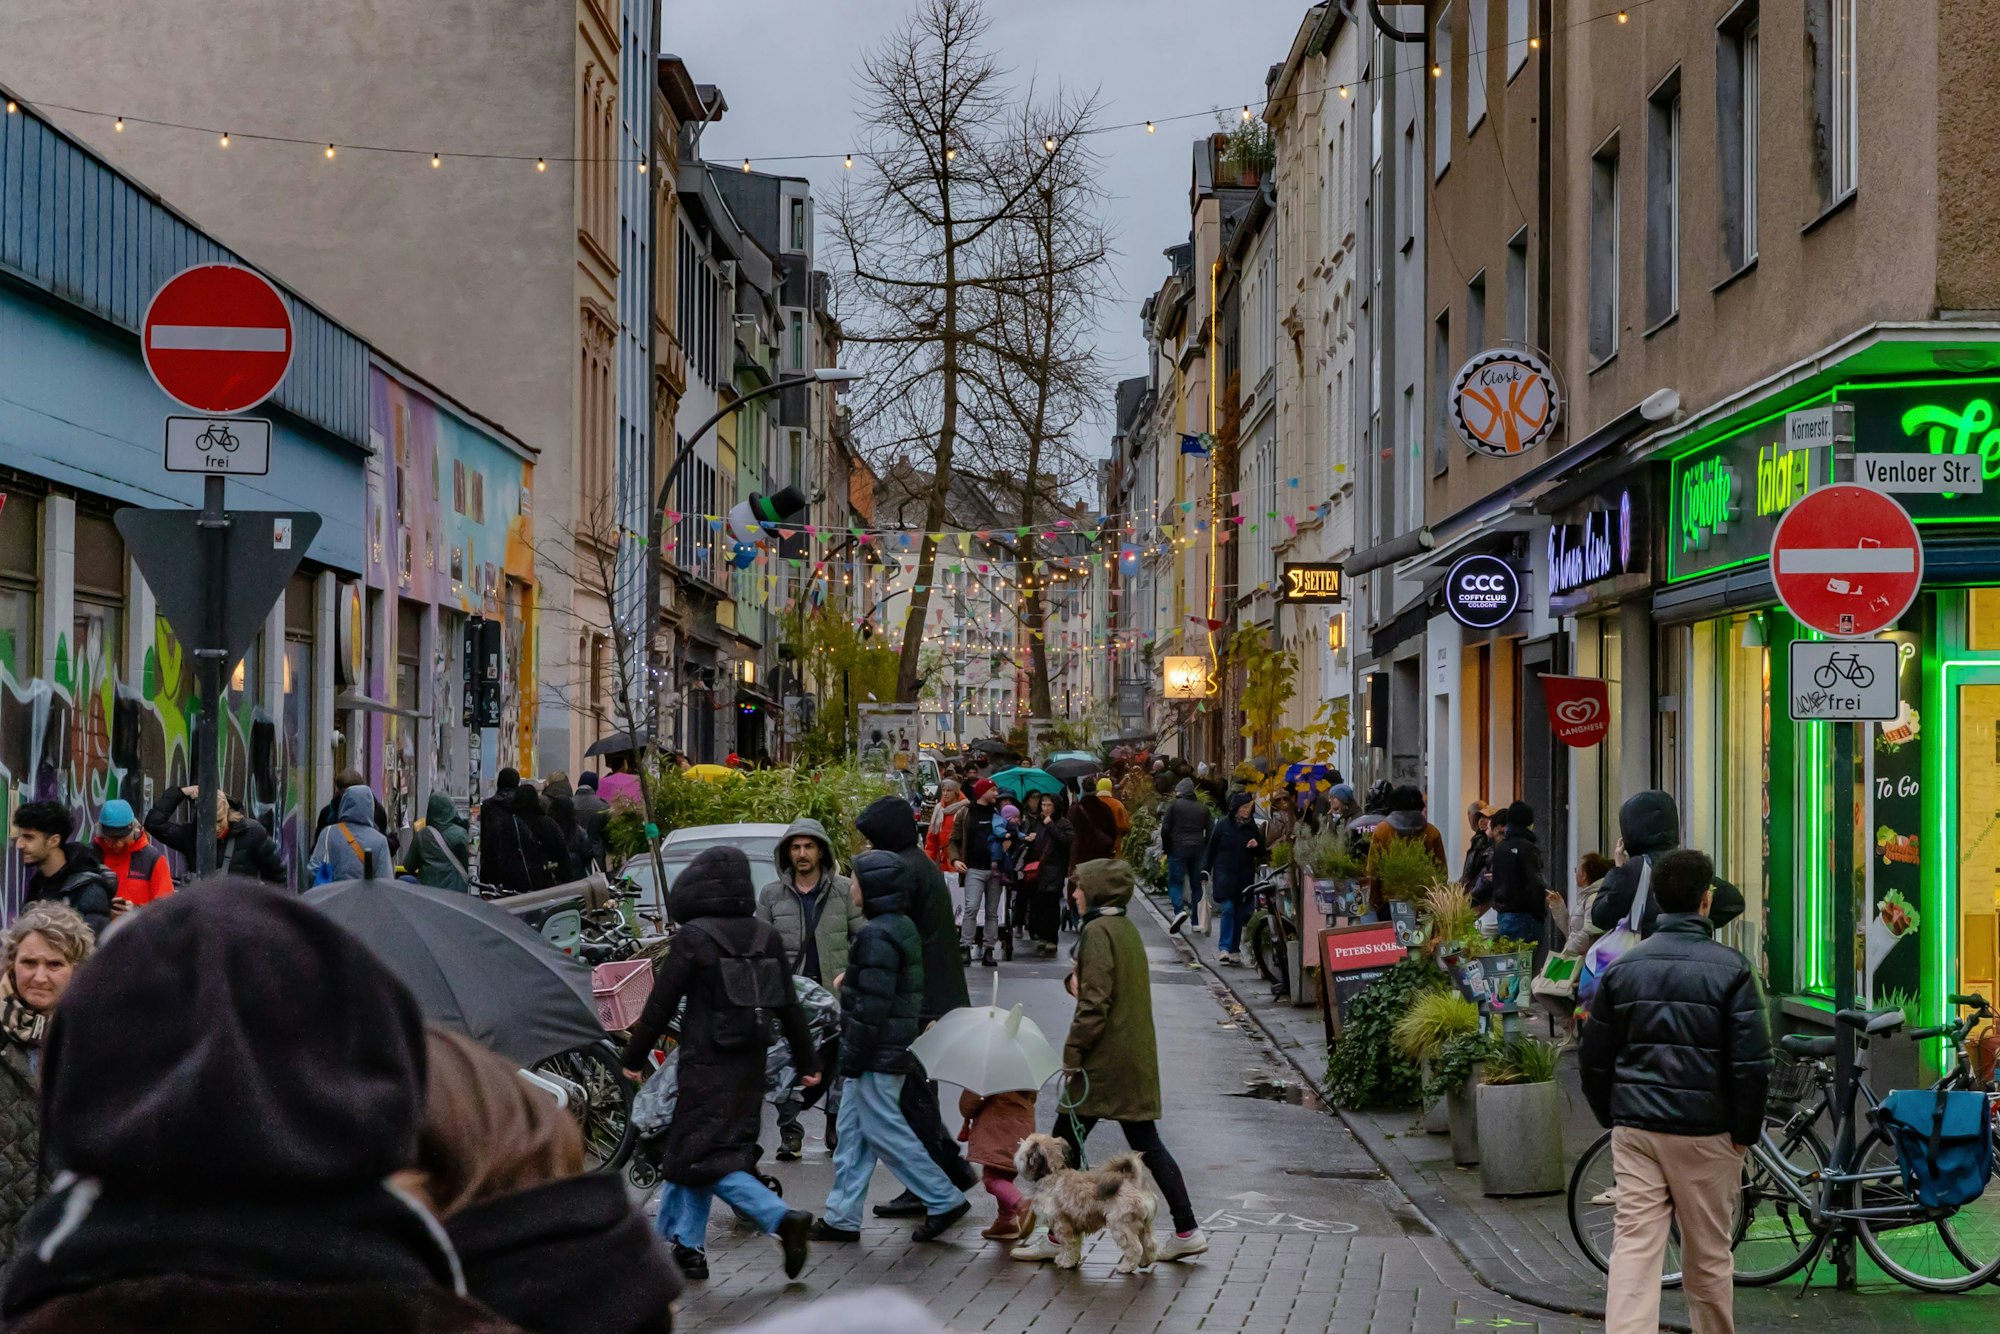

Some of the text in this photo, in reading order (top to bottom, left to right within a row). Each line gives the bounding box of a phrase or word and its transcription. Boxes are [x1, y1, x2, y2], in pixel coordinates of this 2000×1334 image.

[1480, 365, 1522, 386] Kiosk
[1791, 415, 1831, 441] Körnerstr.
[206, 455, 229, 468] frei
[1865, 459, 1976, 482] Venloer Str.
[1304, 570, 1339, 591] SEITEN
[1461, 574, 1505, 591] CCC
[1828, 694, 1861, 710] frei
[1559, 721, 1605, 737] LANGNESE
[1876, 775, 1920, 800] To Go
[1335, 944, 1372, 958] PETERS
